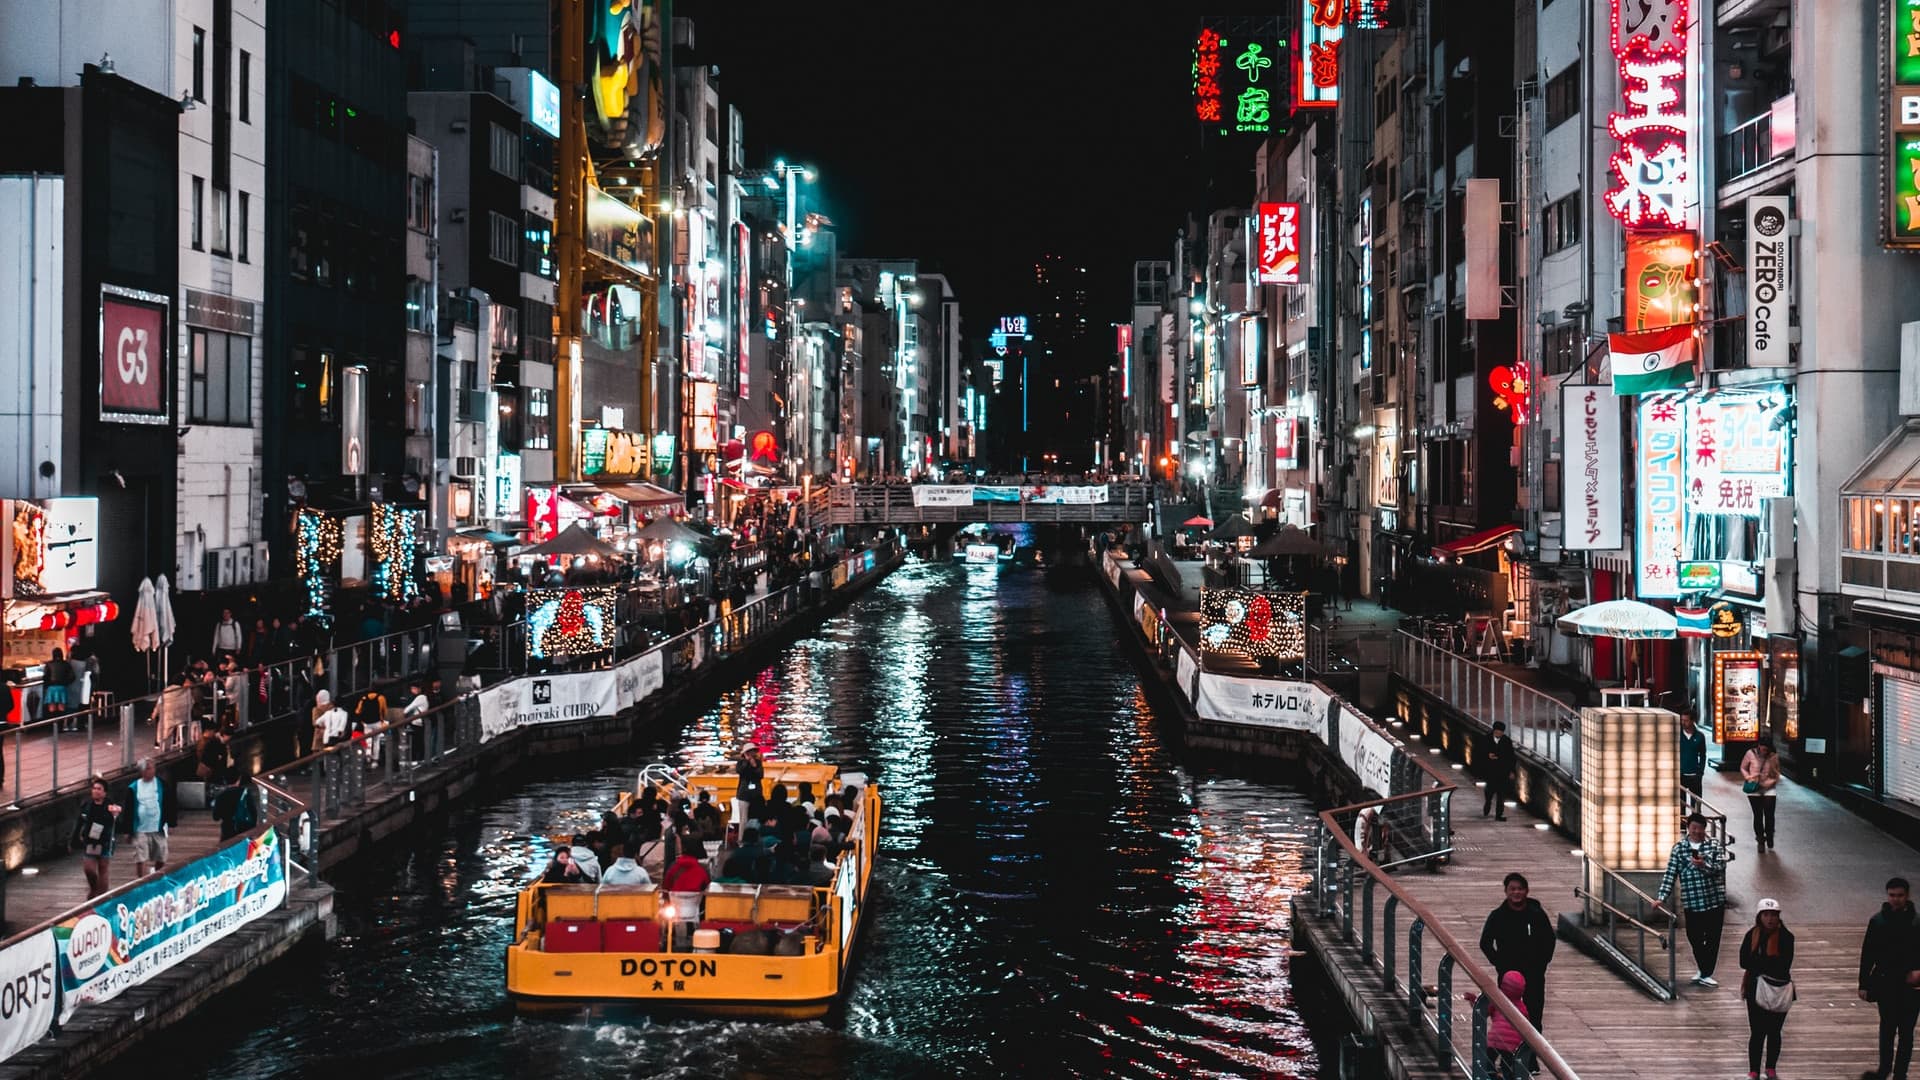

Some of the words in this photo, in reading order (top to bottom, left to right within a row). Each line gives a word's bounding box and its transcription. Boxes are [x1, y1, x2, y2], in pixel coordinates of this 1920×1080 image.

[1755, 241, 1777, 304] ZERO
[1755, 306, 1771, 351] Cafe
[117, 326, 148, 385] G3
[1718, 479, 1753, 509] 免税
[620, 958, 717, 978] DOTON
